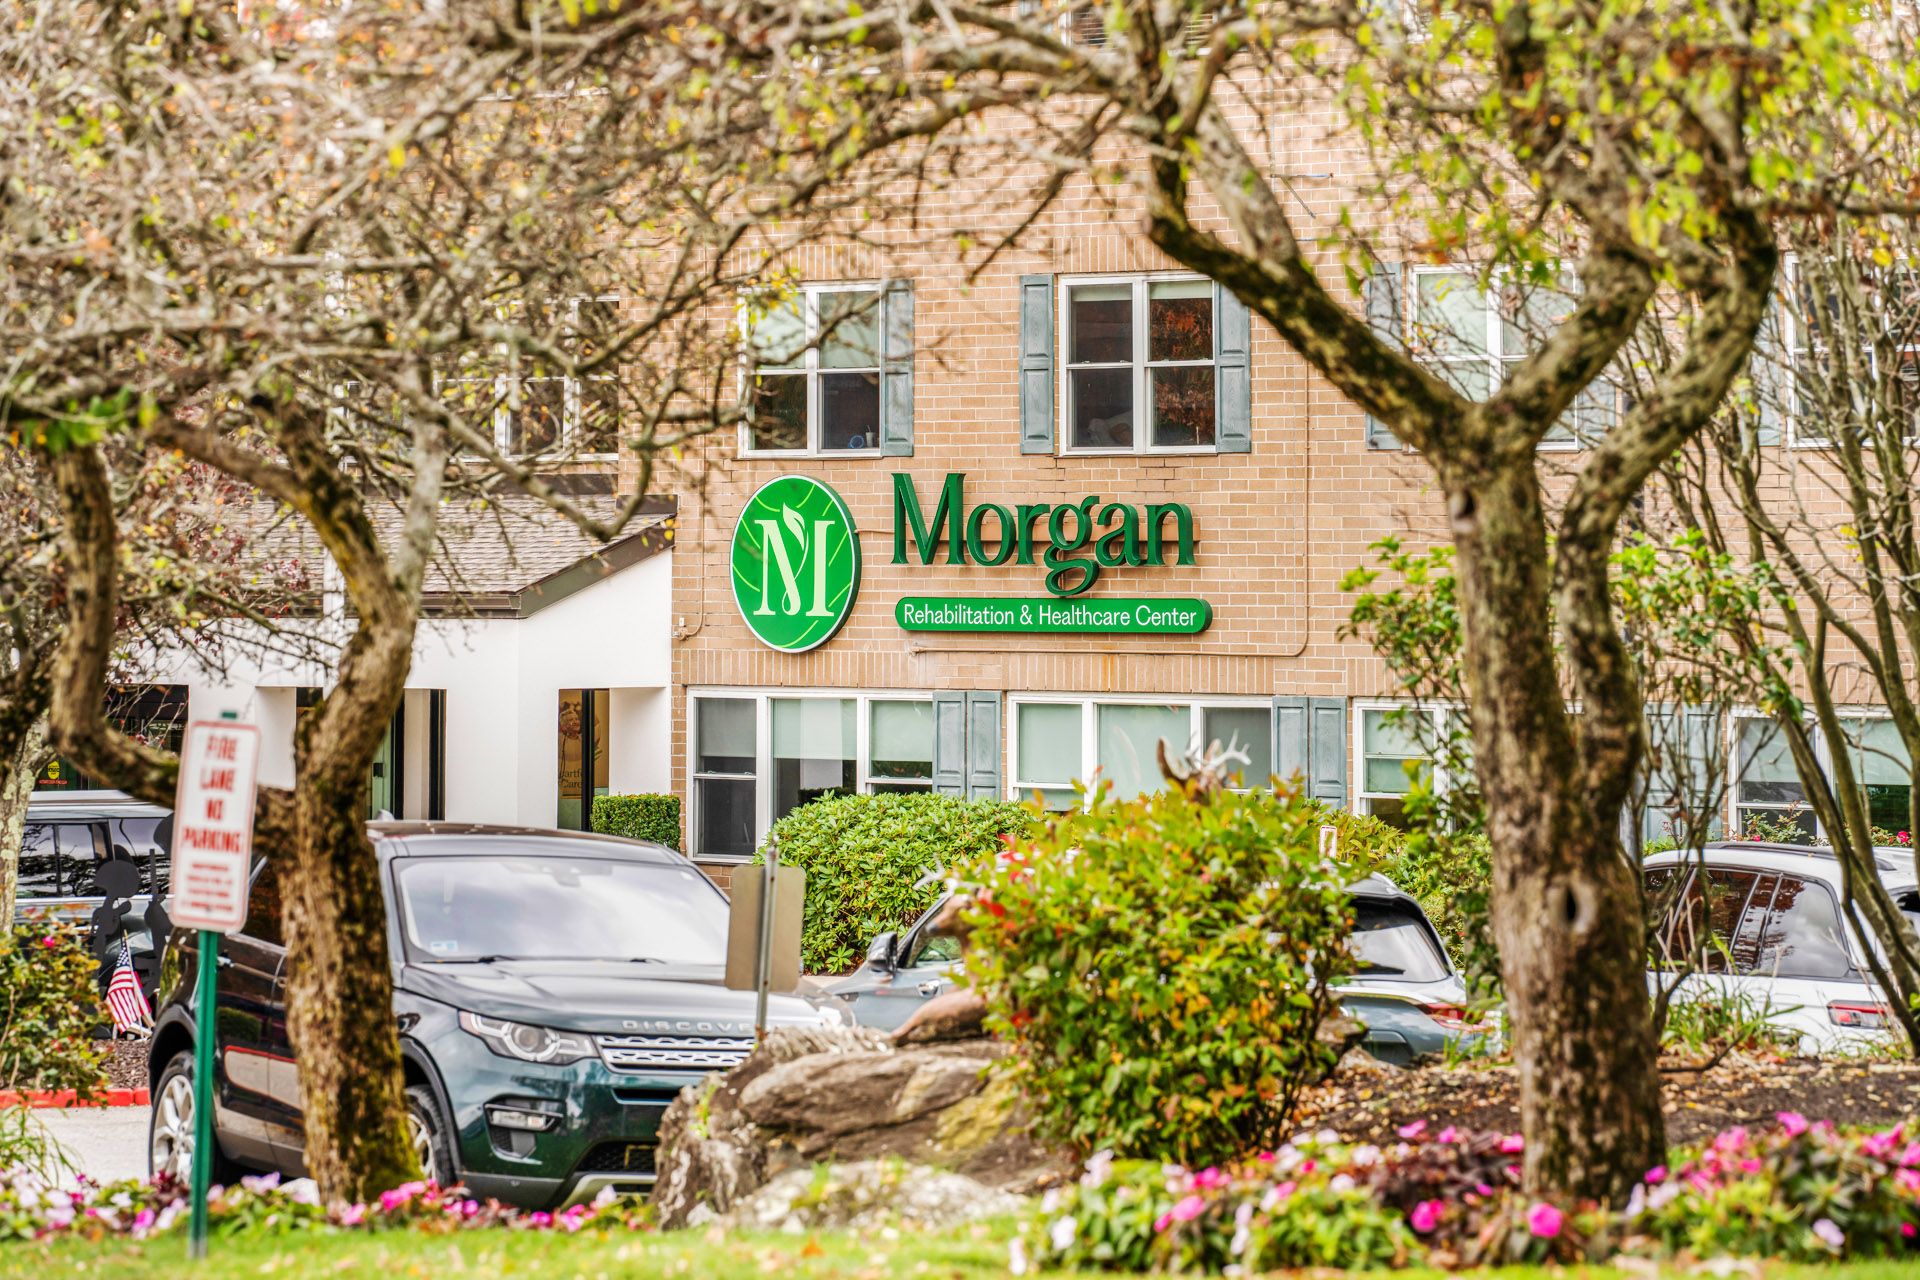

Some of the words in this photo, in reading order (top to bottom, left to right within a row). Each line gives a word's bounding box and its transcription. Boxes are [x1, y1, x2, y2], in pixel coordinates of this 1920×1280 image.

[890, 472, 1197, 597] Morgan
[904, 603, 1014, 625] Rehabilitation
[1019, 604, 1033, 625] &
[1039, 604, 1131, 626] Healthcare
[1135, 604, 1197, 626] Center
[199, 766, 236, 793] LANE
[206, 797, 224, 820] NO
[181, 826, 241, 853] PARKING
[621, 1019, 755, 1033] DISCOVE
